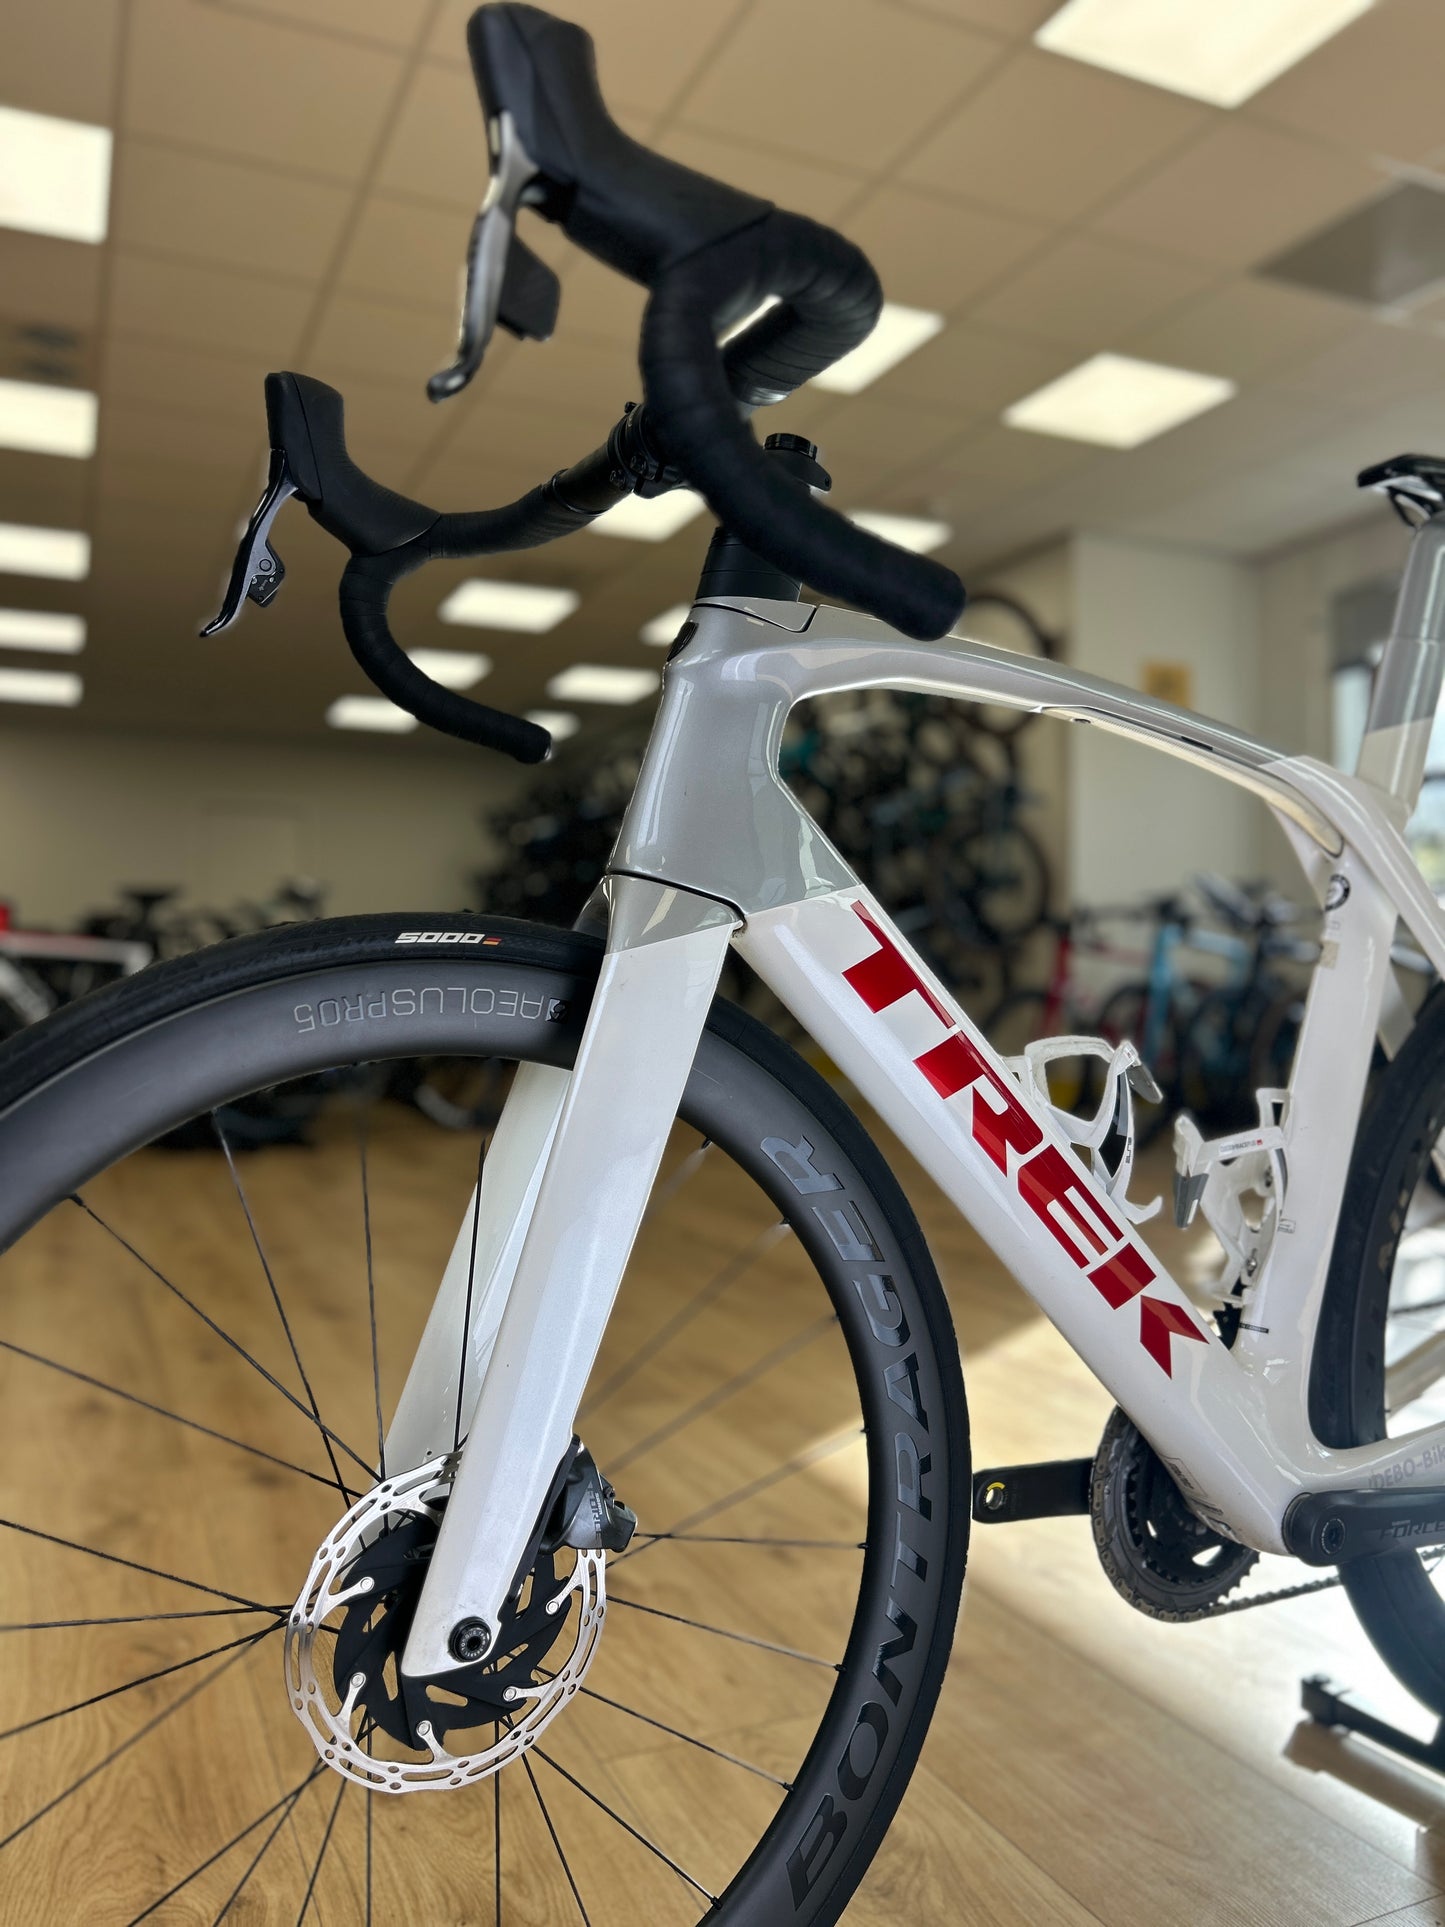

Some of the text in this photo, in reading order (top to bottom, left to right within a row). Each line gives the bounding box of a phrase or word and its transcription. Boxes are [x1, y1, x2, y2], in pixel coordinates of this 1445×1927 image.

[394, 932, 485, 943] 5000
[842, 900, 1210, 1380] TREK
[760, 1135, 932, 1911] BONTRAGER
